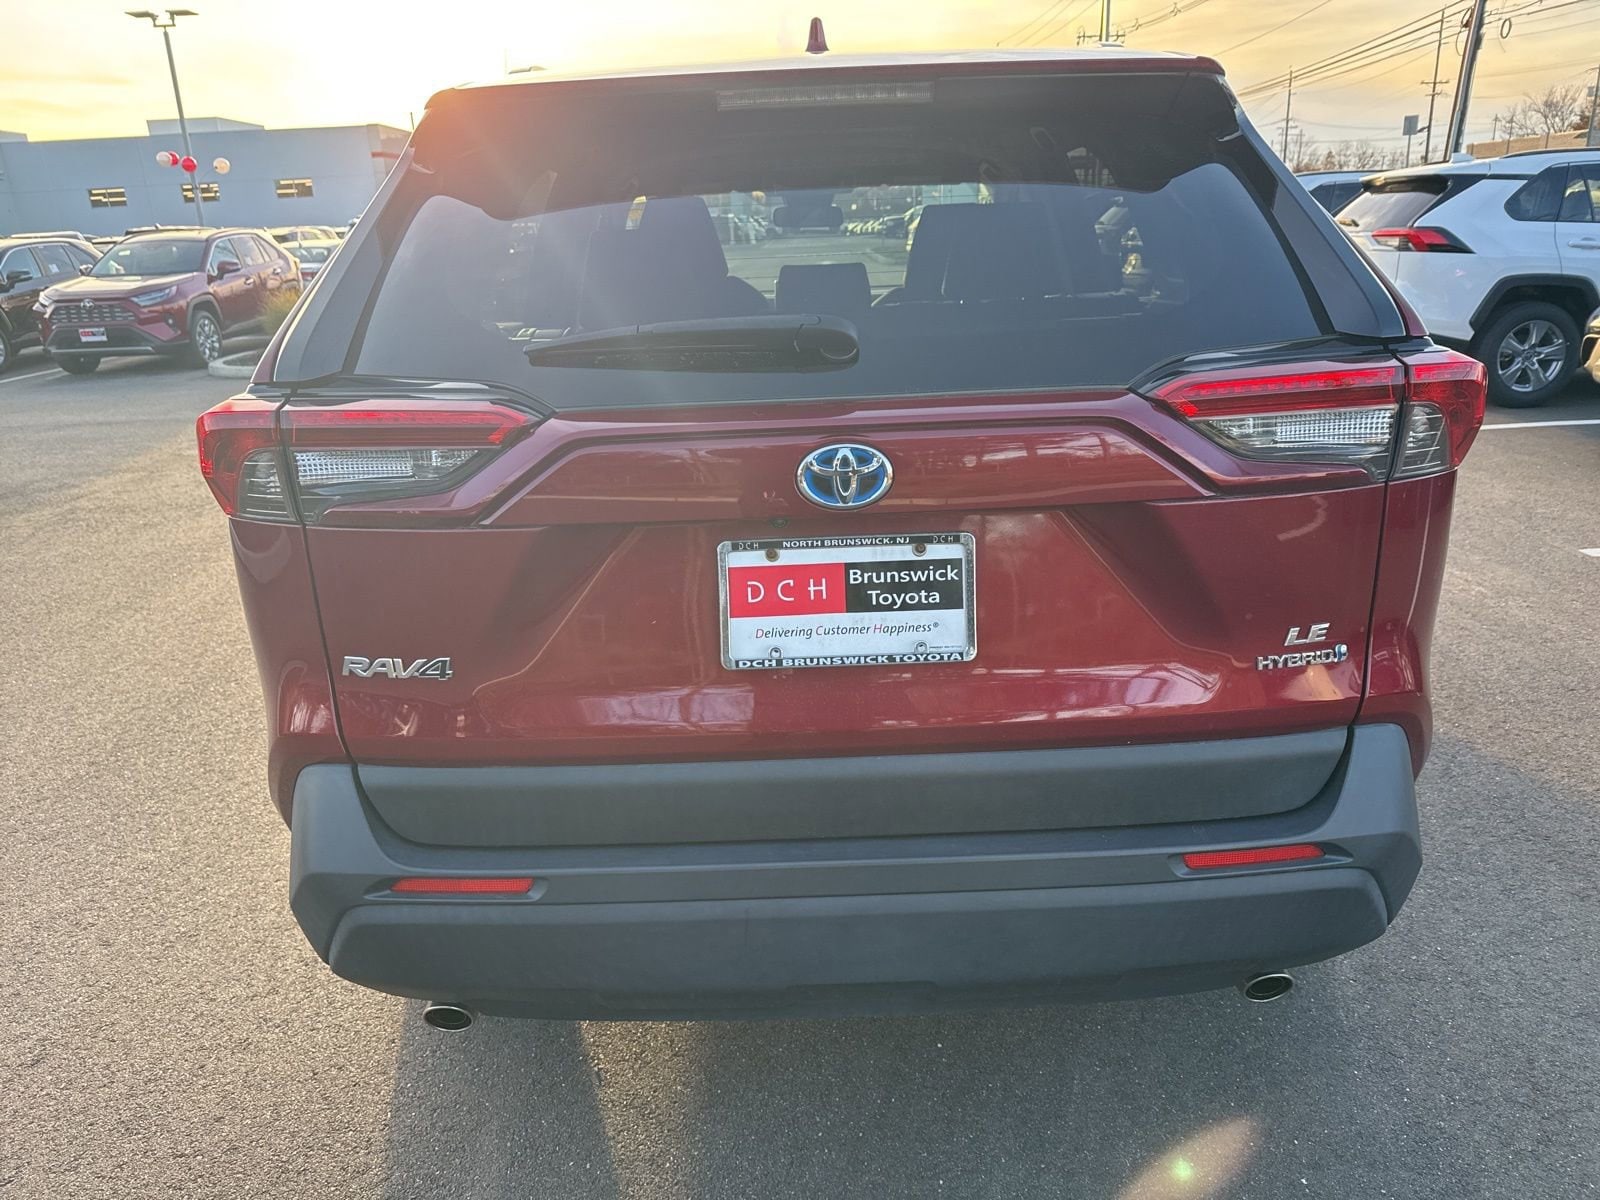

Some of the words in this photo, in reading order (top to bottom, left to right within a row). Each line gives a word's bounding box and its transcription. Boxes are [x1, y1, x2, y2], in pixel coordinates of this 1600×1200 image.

[782, 540, 821, 548] NORTH
[896, 536, 910, 544] NJ
[849, 564, 959, 585] Brunswick
[867, 589, 940, 609] Toyota
[755, 626, 813, 640] Delivering
[815, 624, 871, 636] Customer
[1284, 622, 1331, 647] LE
[341, 655, 454, 681] RAV4
[738, 659, 777, 668] DCH
[782, 655, 889, 667] BRUNSWICK
[892, 652, 962, 663] TOYOTA
[1256, 649, 1337, 671] HYBRID
